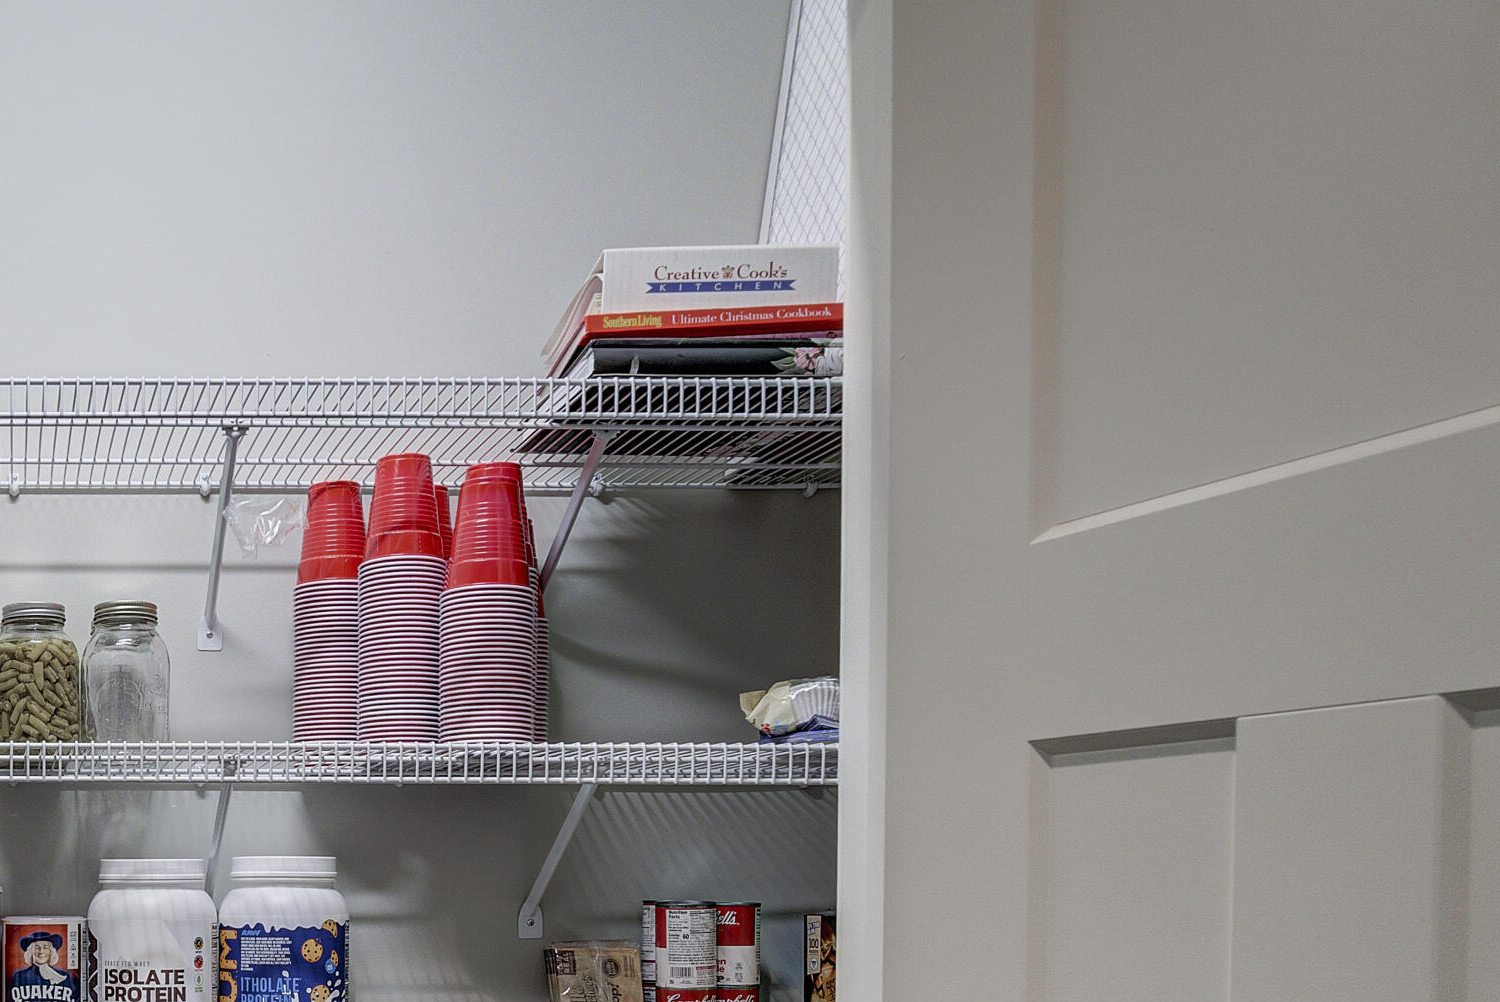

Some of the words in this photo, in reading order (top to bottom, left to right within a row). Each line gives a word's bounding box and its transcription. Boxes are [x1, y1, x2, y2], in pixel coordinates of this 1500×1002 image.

[654, 265, 719, 280] Creative
[737, 261, 788, 279] Cook's
[659, 282, 782, 291] KITCHEN
[603, 316, 638, 328] Southern
[638, 315, 662, 328] Living
[672, 313, 717, 325] Ultimate
[720, 311, 774, 322] Christmas
[776, 307, 832, 318] Cookbook
[809, 938, 819, 949] 100
[104, 968, 185, 985] ISOLATE
[240, 977, 301, 993] ITHOLATE
[104, 986, 186, 1002] PROTEIN
